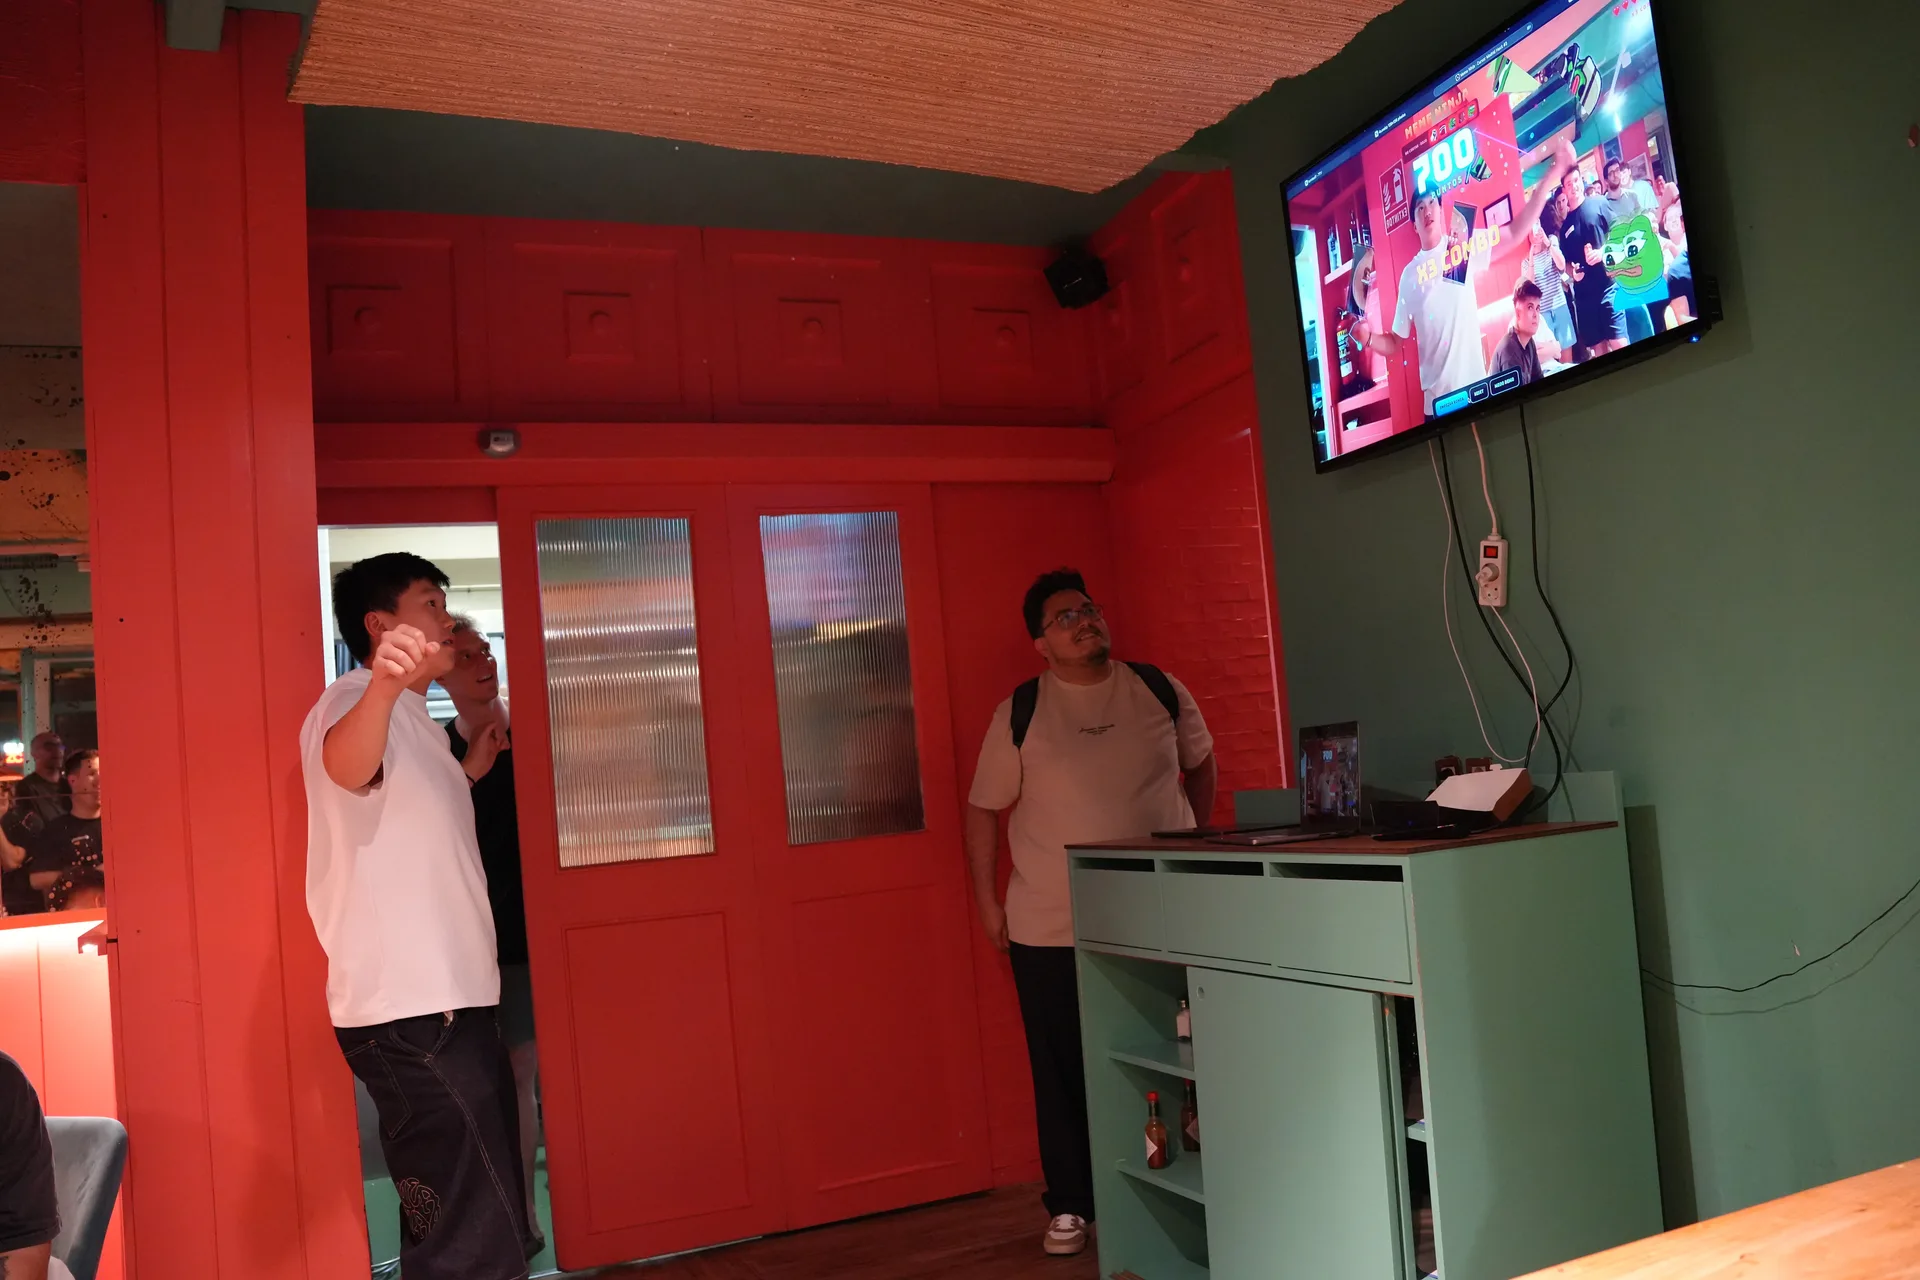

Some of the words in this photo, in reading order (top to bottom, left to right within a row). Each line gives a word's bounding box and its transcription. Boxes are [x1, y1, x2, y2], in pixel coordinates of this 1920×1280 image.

[1405, 112, 1432, 139] MEME
[1412, 128, 1475, 195] 700
[1441, 224, 1501, 271] COMBO
